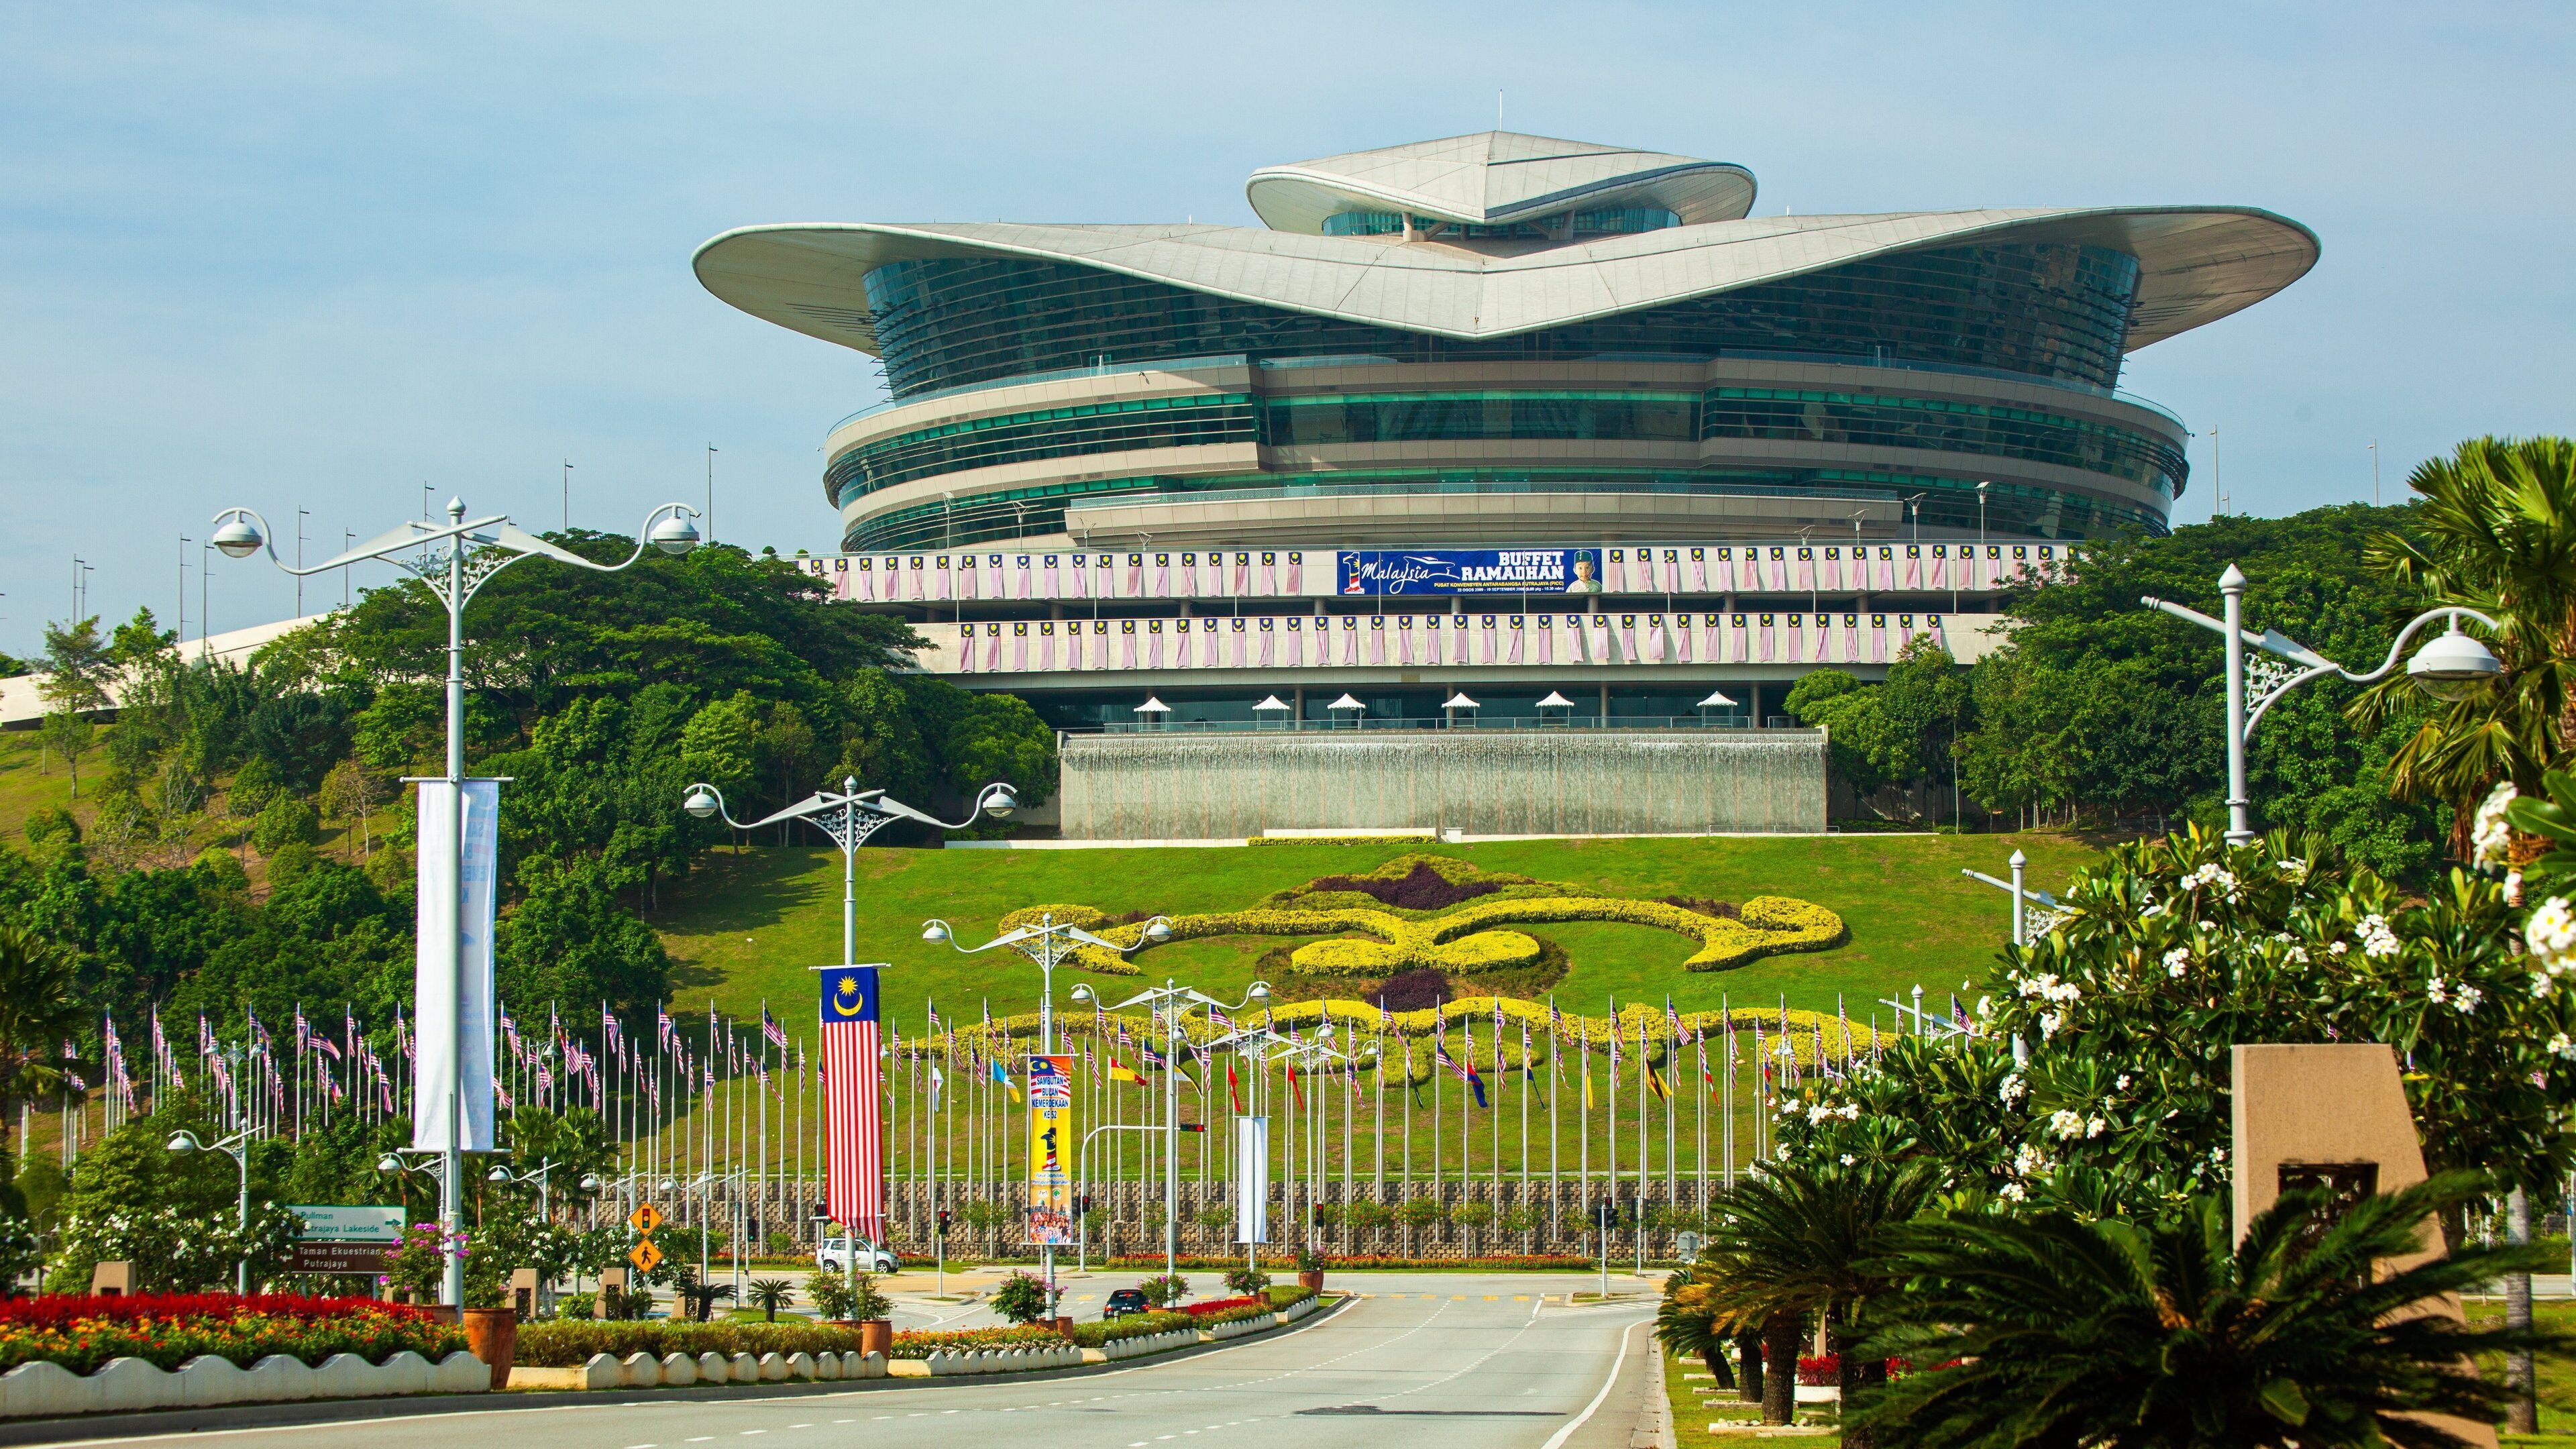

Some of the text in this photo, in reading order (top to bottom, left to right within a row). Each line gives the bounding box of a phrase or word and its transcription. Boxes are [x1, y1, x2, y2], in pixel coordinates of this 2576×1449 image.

[1499, 551, 1564, 566] BUFFET
[1361, 561, 1430, 594] Malaysia
[1462, 566, 1564, 581] RAMADHAN
[1036, 1077, 1064, 1085] SAMBUTAN
[1042, 1088, 1058, 1096] BULAN
[1032, 1099, 1069, 1108] KEMERDEKAAN
[1051, 1111, 1057, 1119] 52
[300, 1211, 333, 1220] Pullman
[304, 1224, 380, 1234] trajaya Lakeside
[299, 1246, 380, 1256] Taman Ekuestrian
[304, 1259, 347, 1269] Putrajaya
